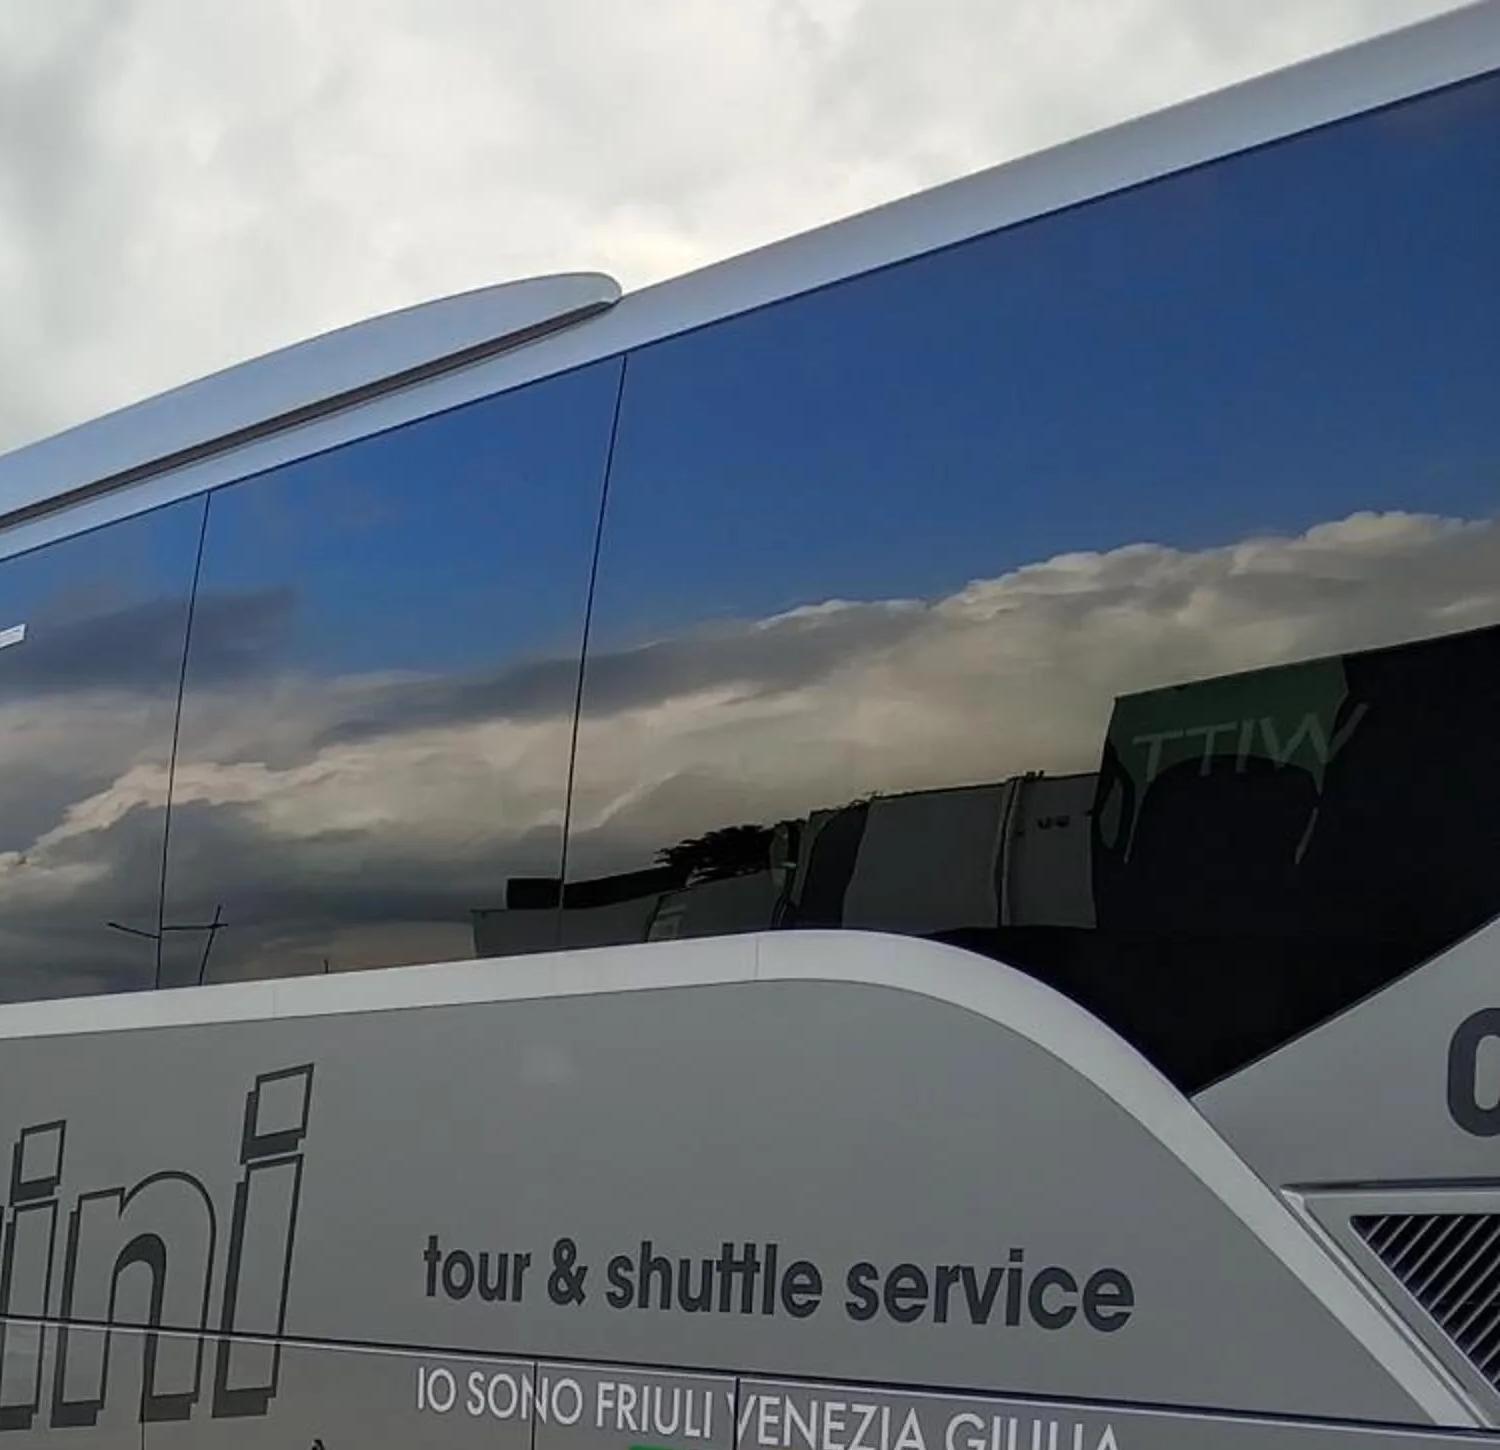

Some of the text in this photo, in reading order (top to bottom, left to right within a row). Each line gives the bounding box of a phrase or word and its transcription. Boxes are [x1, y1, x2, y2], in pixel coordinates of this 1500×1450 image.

[424, 1235, 1135, 1333] tour & shuttle service
[417, 1366, 457, 1413] IO
[466, 1371, 583, 1425] SONO
[596, 1381, 714, 1440] FRIULI
